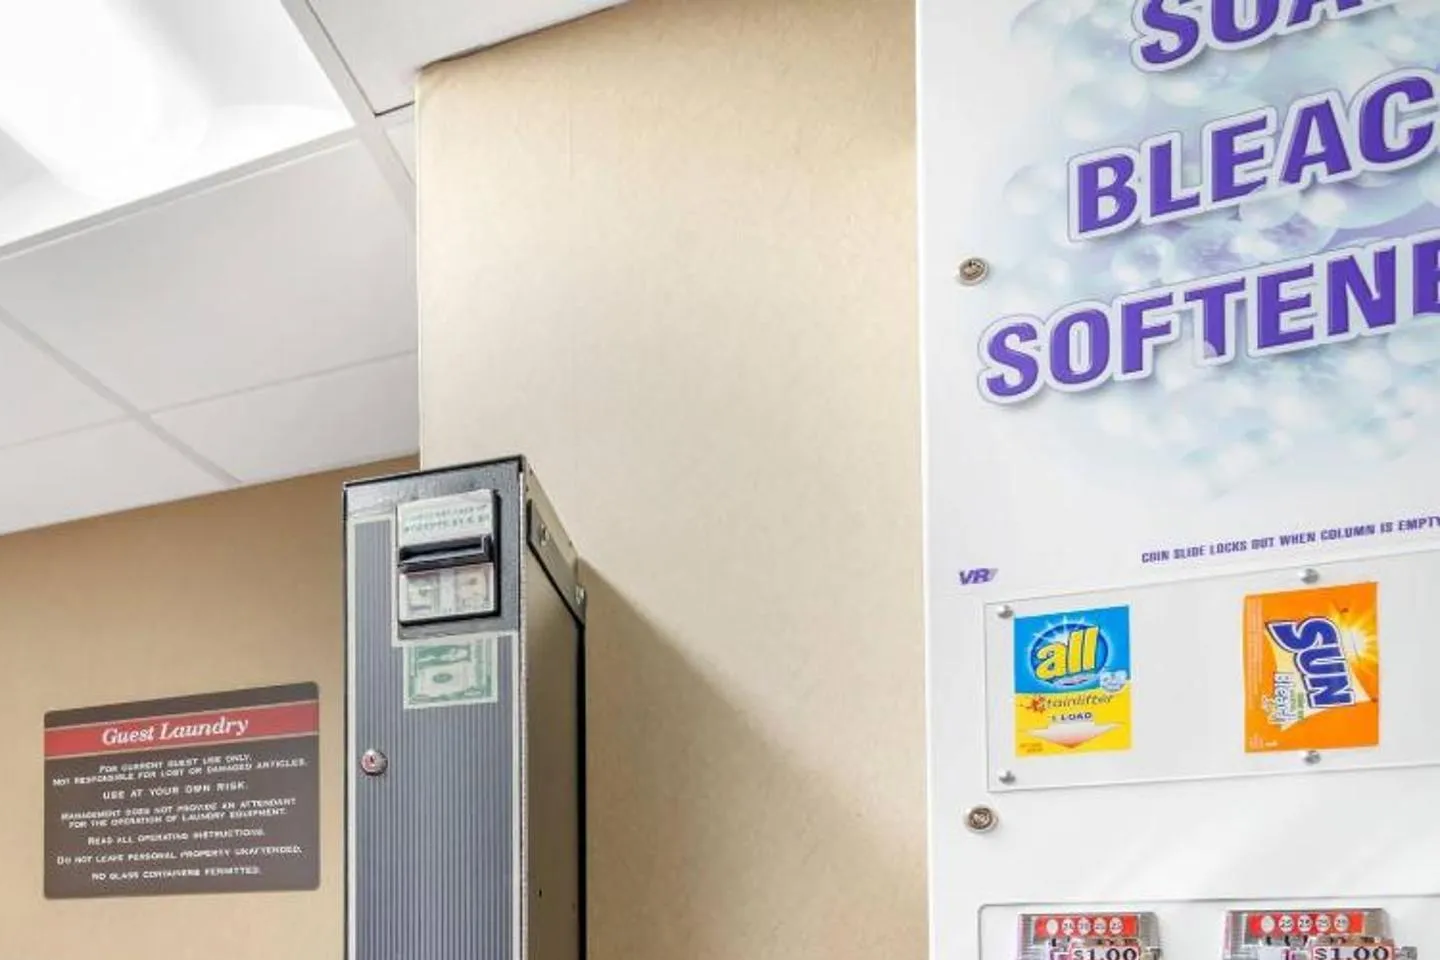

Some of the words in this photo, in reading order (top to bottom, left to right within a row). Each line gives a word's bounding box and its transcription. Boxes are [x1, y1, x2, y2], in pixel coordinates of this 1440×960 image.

[1077, 75, 1435, 234] BLEAC
[1141, 550, 1170, 563] COIN
[1173, 546, 1207, 560] SLIDE
[1210, 541, 1248, 555] LOCKS
[1251, 537, 1275, 550] OUT
[1279, 531, 1316, 546] WHEN
[1320, 524, 1376, 541] COLUMN
[1380, 521, 1393, 534] IS
[1036, 626, 1100, 680] all
[1265, 616, 1357, 710] SUN
[102, 726, 155, 745] Guest
[159, 716, 249, 740] Laundry
[1061, 712, 1093, 721] LOAD
[103, 790, 125, 799] USE
[130, 788, 144, 798] AT
[149, 786, 179, 796] YOUR
[185, 784, 210, 794] OWN
